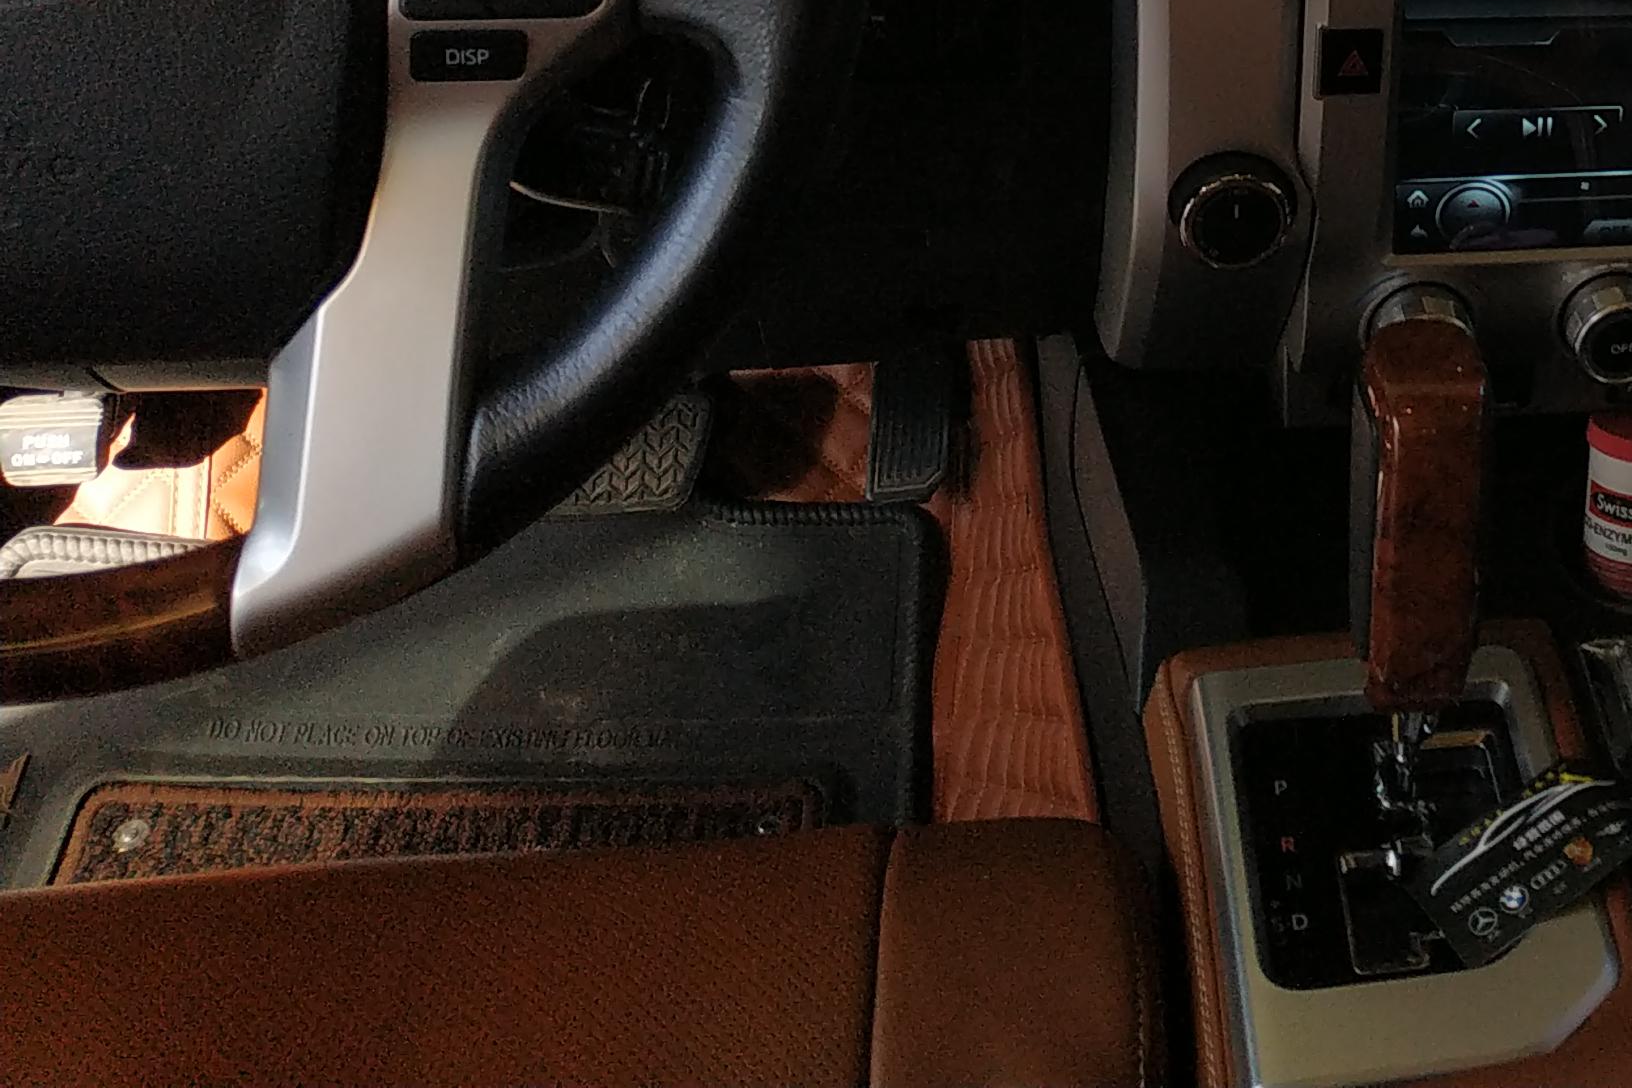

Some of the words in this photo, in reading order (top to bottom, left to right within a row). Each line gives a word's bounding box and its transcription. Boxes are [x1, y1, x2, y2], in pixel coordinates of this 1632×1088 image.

[445, 48, 491, 65] DISP
[208, 717, 241, 740] DO
[245, 718, 291, 743] NOT
[1273, 779, 1288, 796] P
[1280, 836, 1296, 853] R
[1285, 875, 1303, 891] N
[1291, 913, 1309, 931] D
